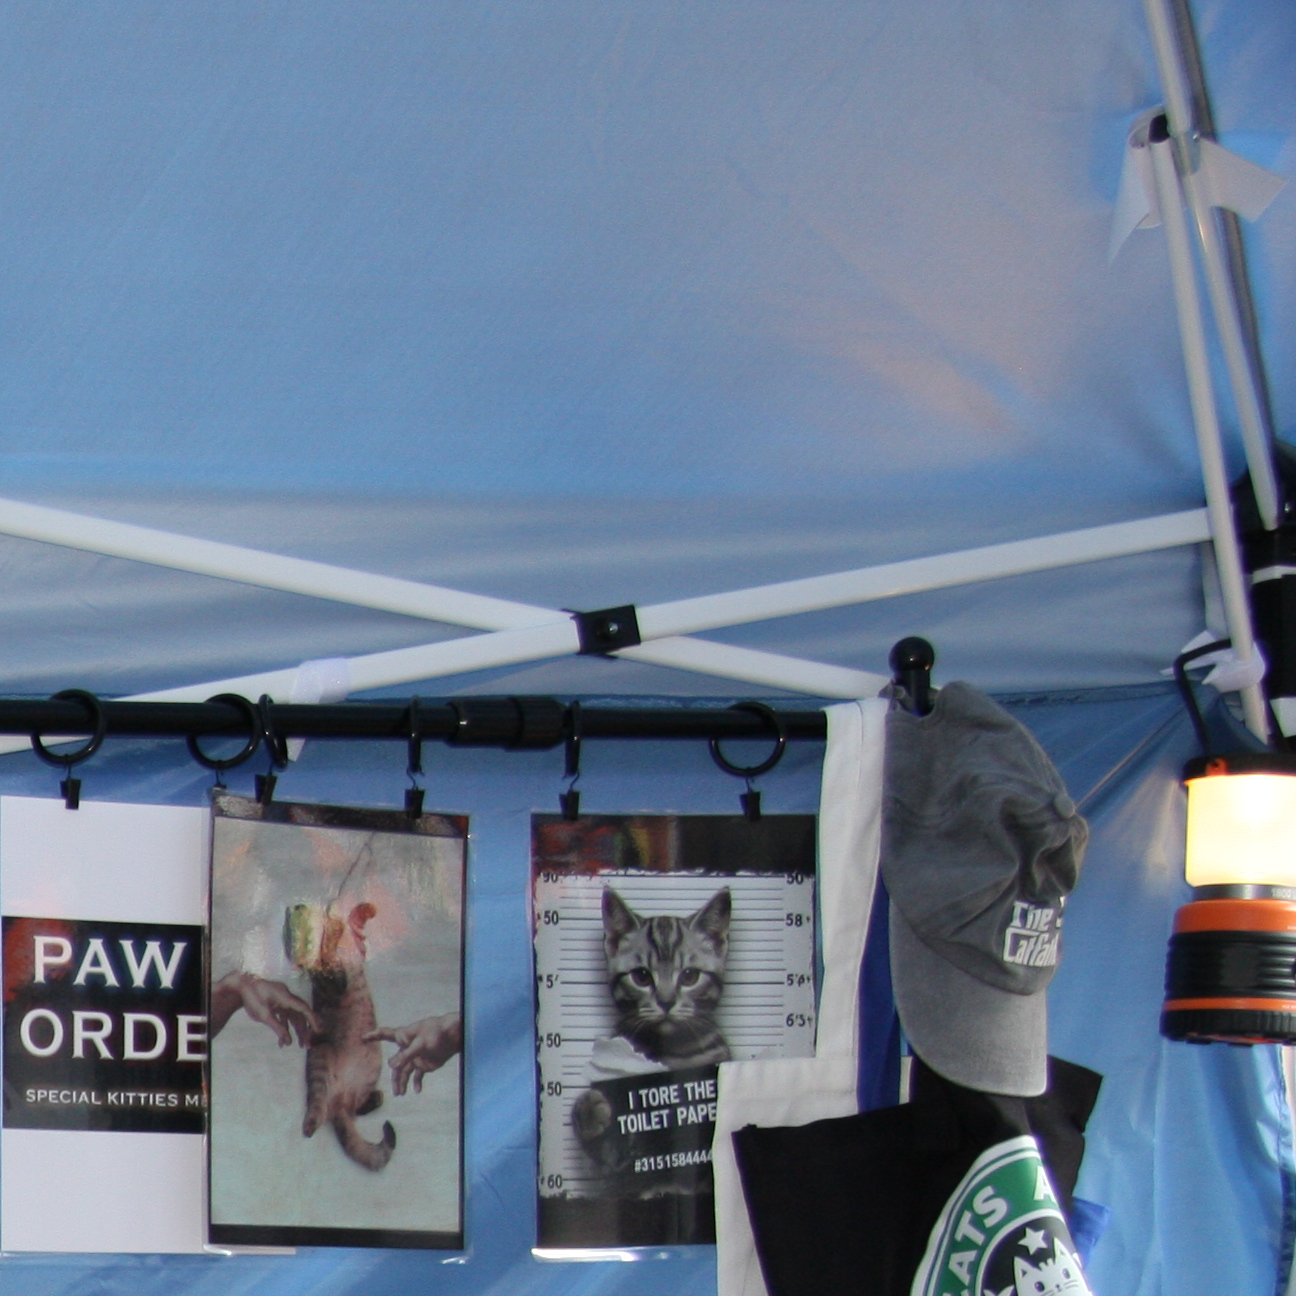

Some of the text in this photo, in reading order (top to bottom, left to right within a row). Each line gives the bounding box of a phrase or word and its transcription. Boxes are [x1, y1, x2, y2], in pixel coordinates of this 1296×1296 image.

[33, 935, 187, 989] PAW
[26, 1089, 101, 1105] SPECIAL
[108, 1092, 178, 1107] KITTIES
[629, 1080, 716, 1110] I TORE THE
[617, 1109, 669, 1134] TOILET
